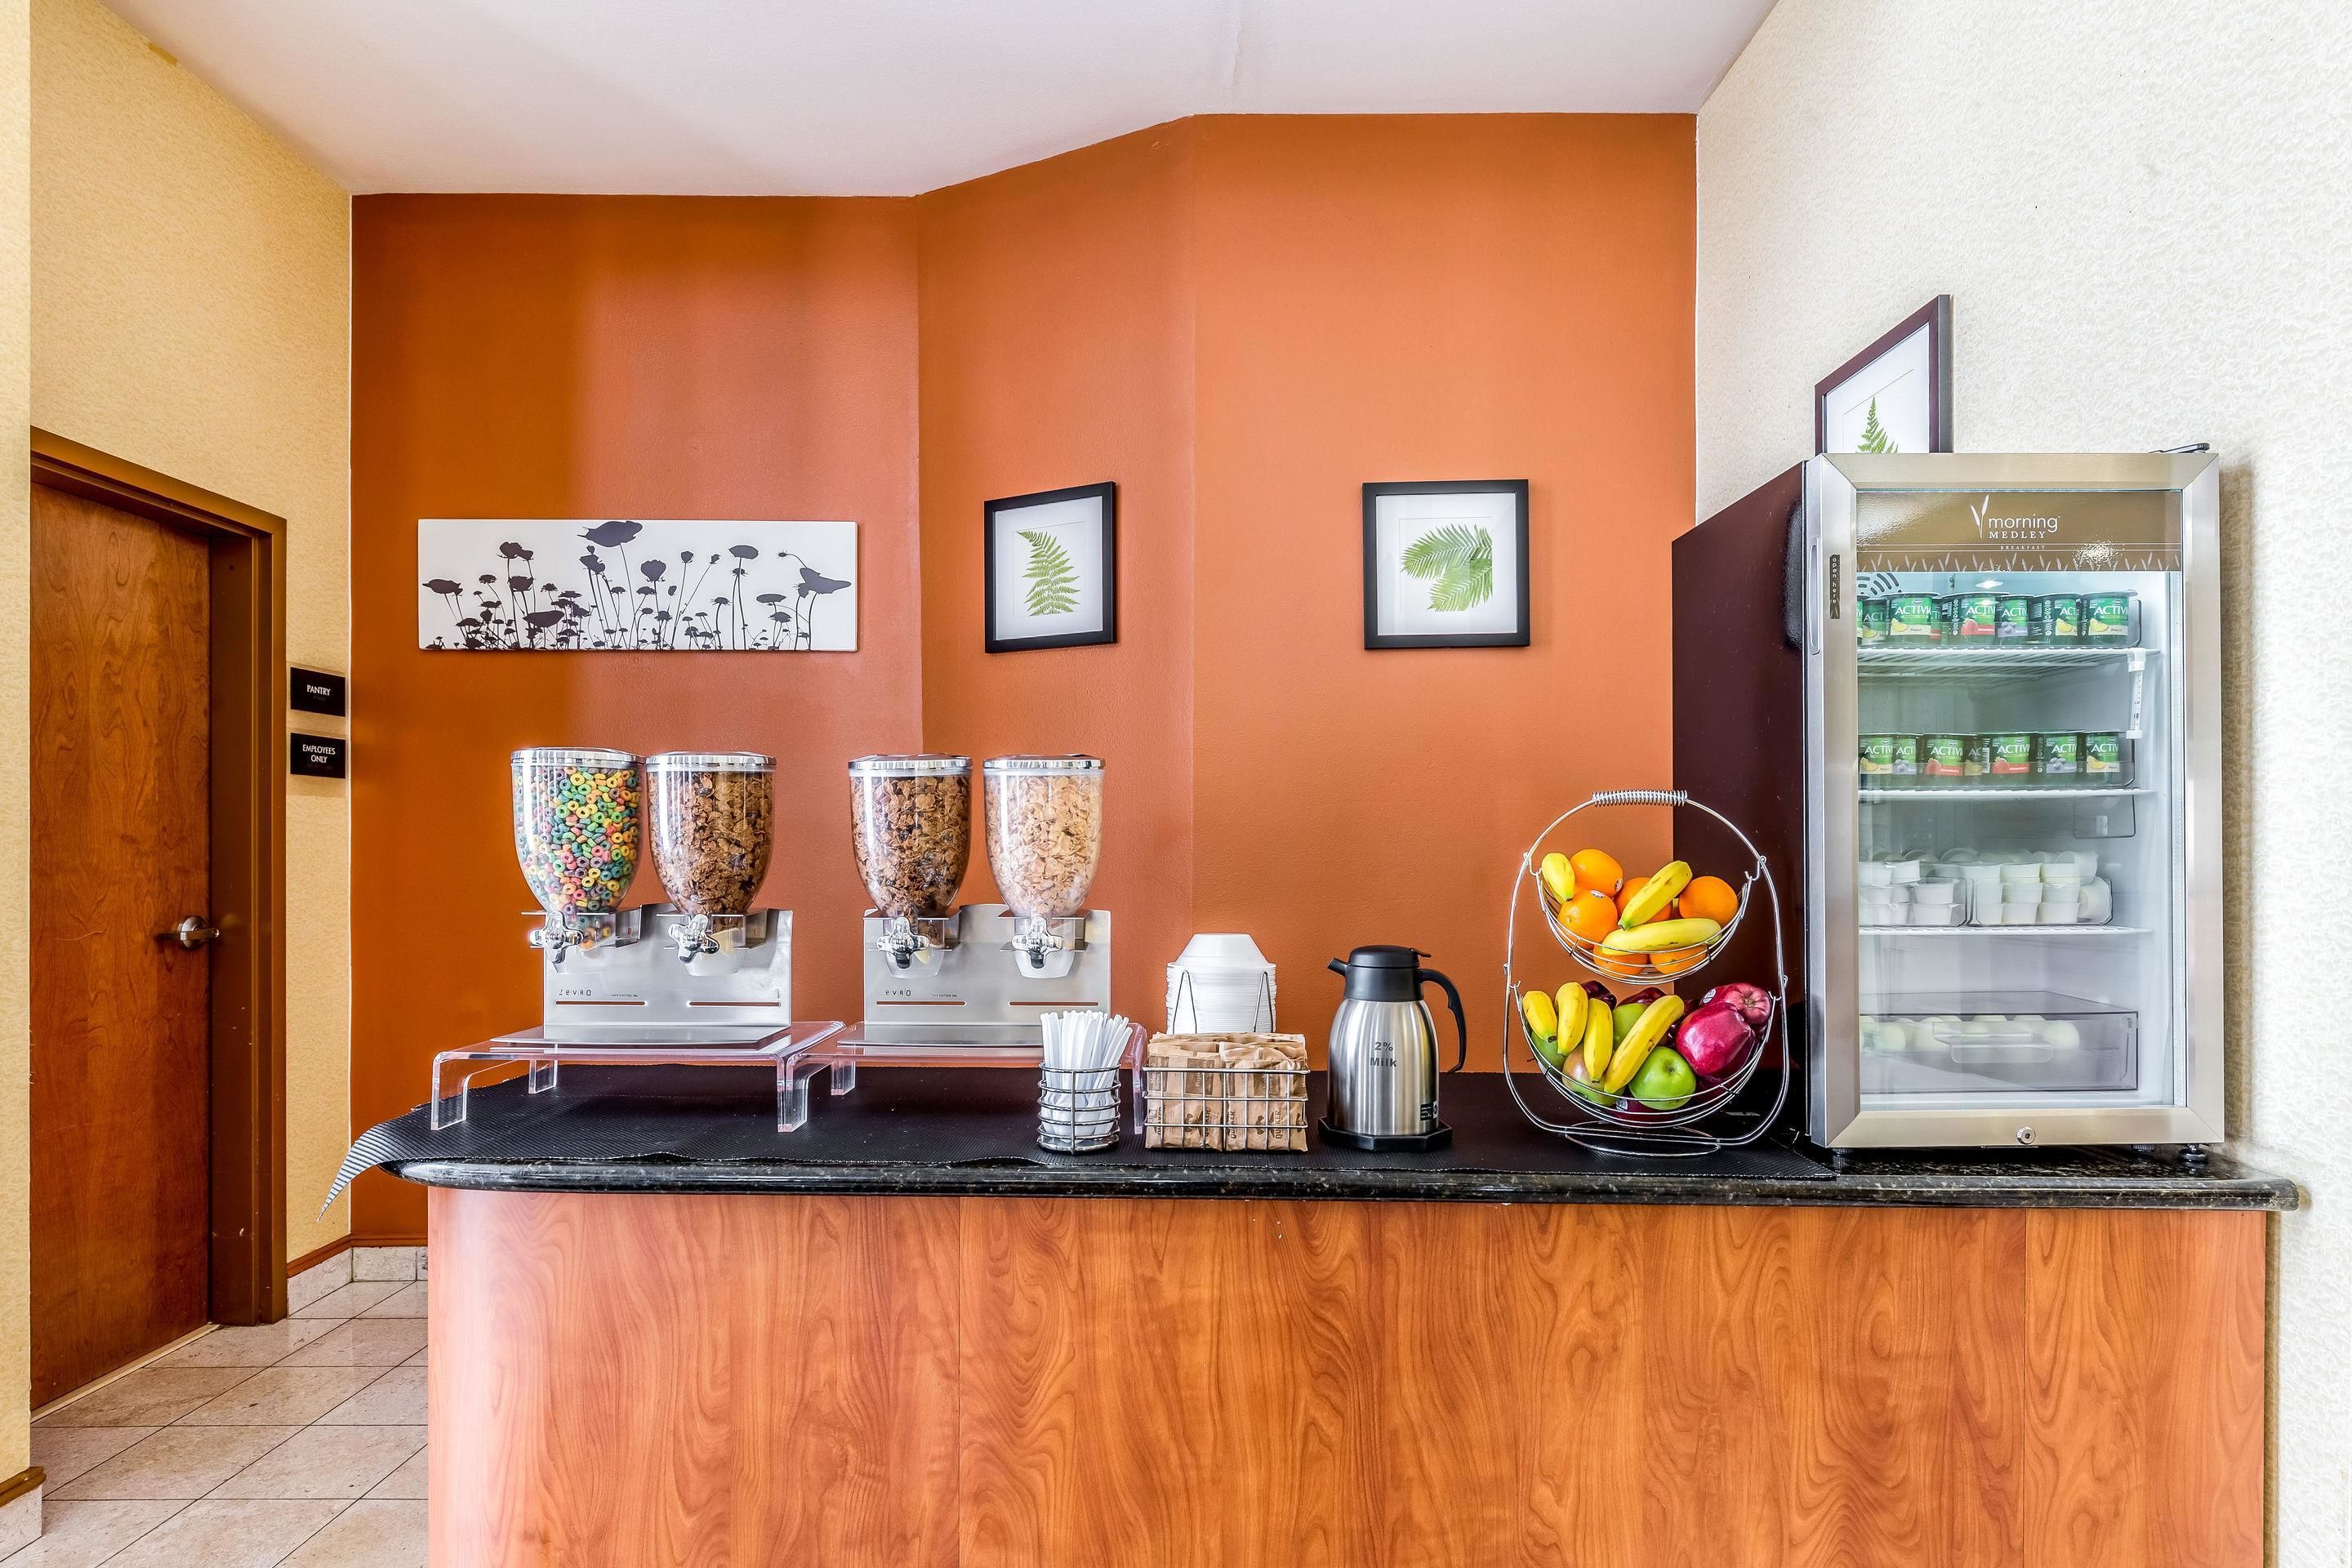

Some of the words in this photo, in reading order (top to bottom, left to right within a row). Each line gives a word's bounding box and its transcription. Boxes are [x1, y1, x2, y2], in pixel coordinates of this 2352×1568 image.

[1988, 513, 2058, 533] morning
[1989, 531, 2046, 539] MEDLEY
[307, 685, 331, 696] PANTRY
[302, 744, 336, 755] EMPLOYEES
[311, 755, 327, 763] ONLY
[1374, 1041, 1393, 1051] 2%
[1370, 1056, 1397, 1068] Milk
